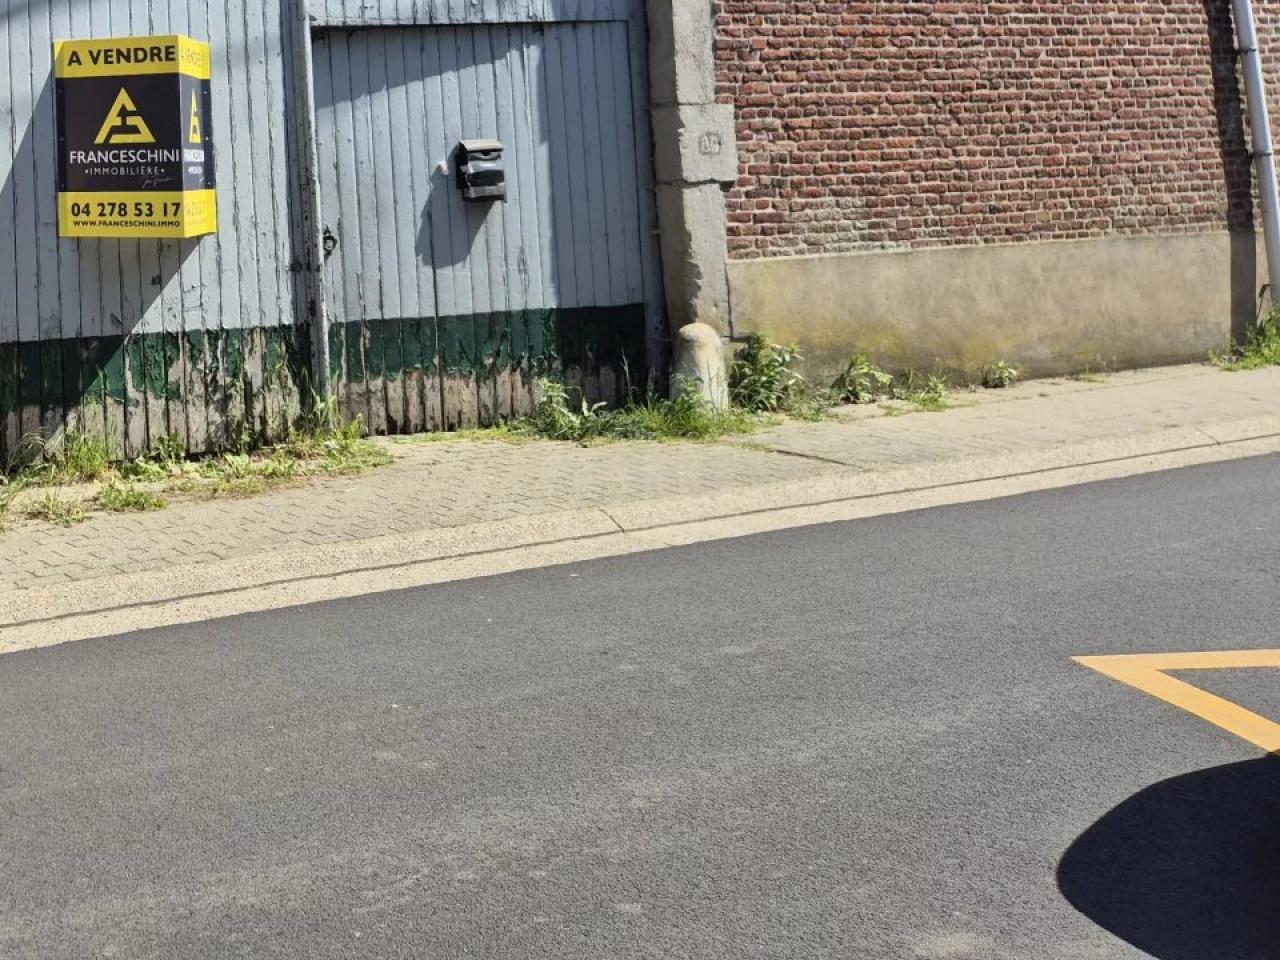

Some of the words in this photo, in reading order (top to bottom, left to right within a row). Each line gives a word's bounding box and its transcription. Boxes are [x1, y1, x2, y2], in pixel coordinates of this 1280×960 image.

[67, 48, 82, 66] A
[88, 45, 176, 65] VENDRE
[70, 148, 180, 164] FRANCESCHINI
[71, 202, 91, 217] 04
[97, 202, 128, 217] 278
[134, 202, 154, 217] 53
[163, 202, 181, 217] 17
